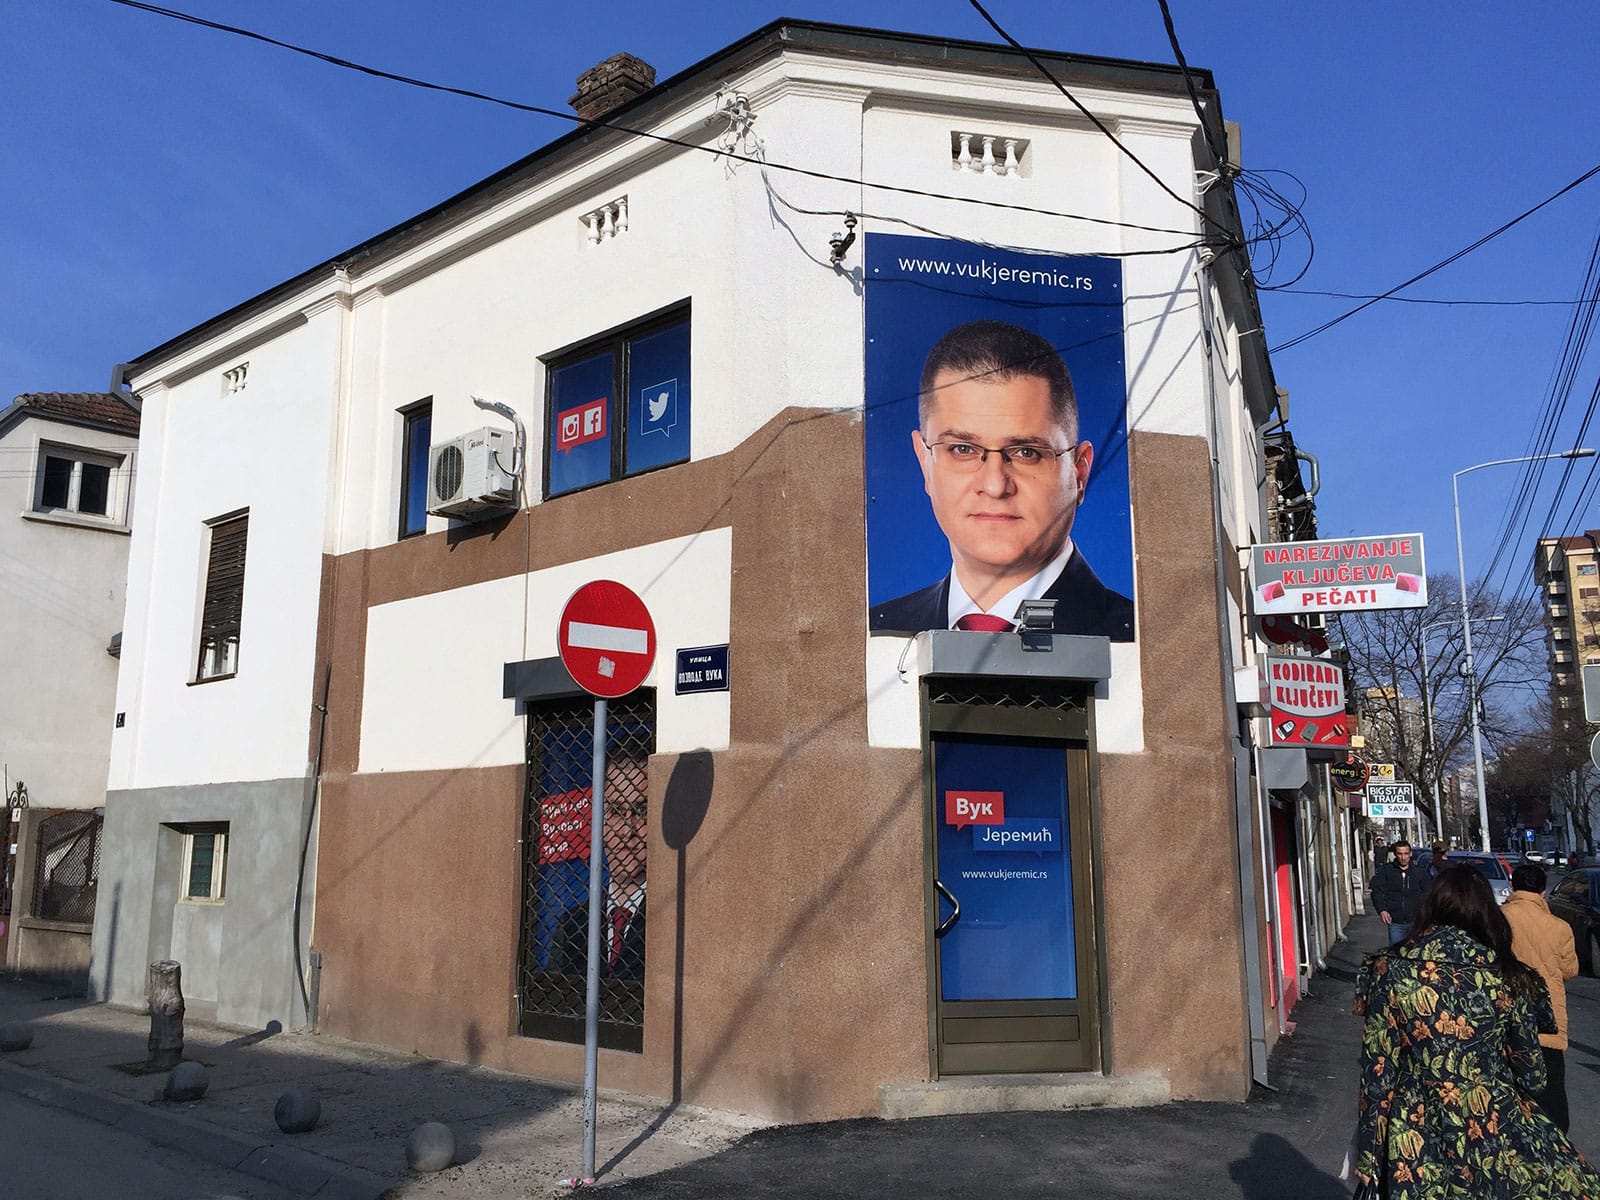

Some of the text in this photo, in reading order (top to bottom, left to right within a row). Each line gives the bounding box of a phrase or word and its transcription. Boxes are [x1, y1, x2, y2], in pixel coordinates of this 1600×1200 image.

[898, 257, 1093, 291] www.vukjeremic.rs
[1263, 540, 1412, 565] NAREZIVANJE
[1282, 562, 1395, 585] KLJUČEVA
[1302, 588, 1377, 606] PEČATI
[705, 668, 723, 681] ВУКА
[1272, 662, 1339, 684] KODIRANI
[1276, 685, 1339, 708] KLJUČEVI
[1370, 786, 1410, 795] BIG STAR
[1373, 795, 1409, 803] TRAVEL
[956, 798, 993, 820] Вук
[982, 827, 1052, 846] Јеремић
[961, 869, 1048, 881] www.vukjeremic.rs
